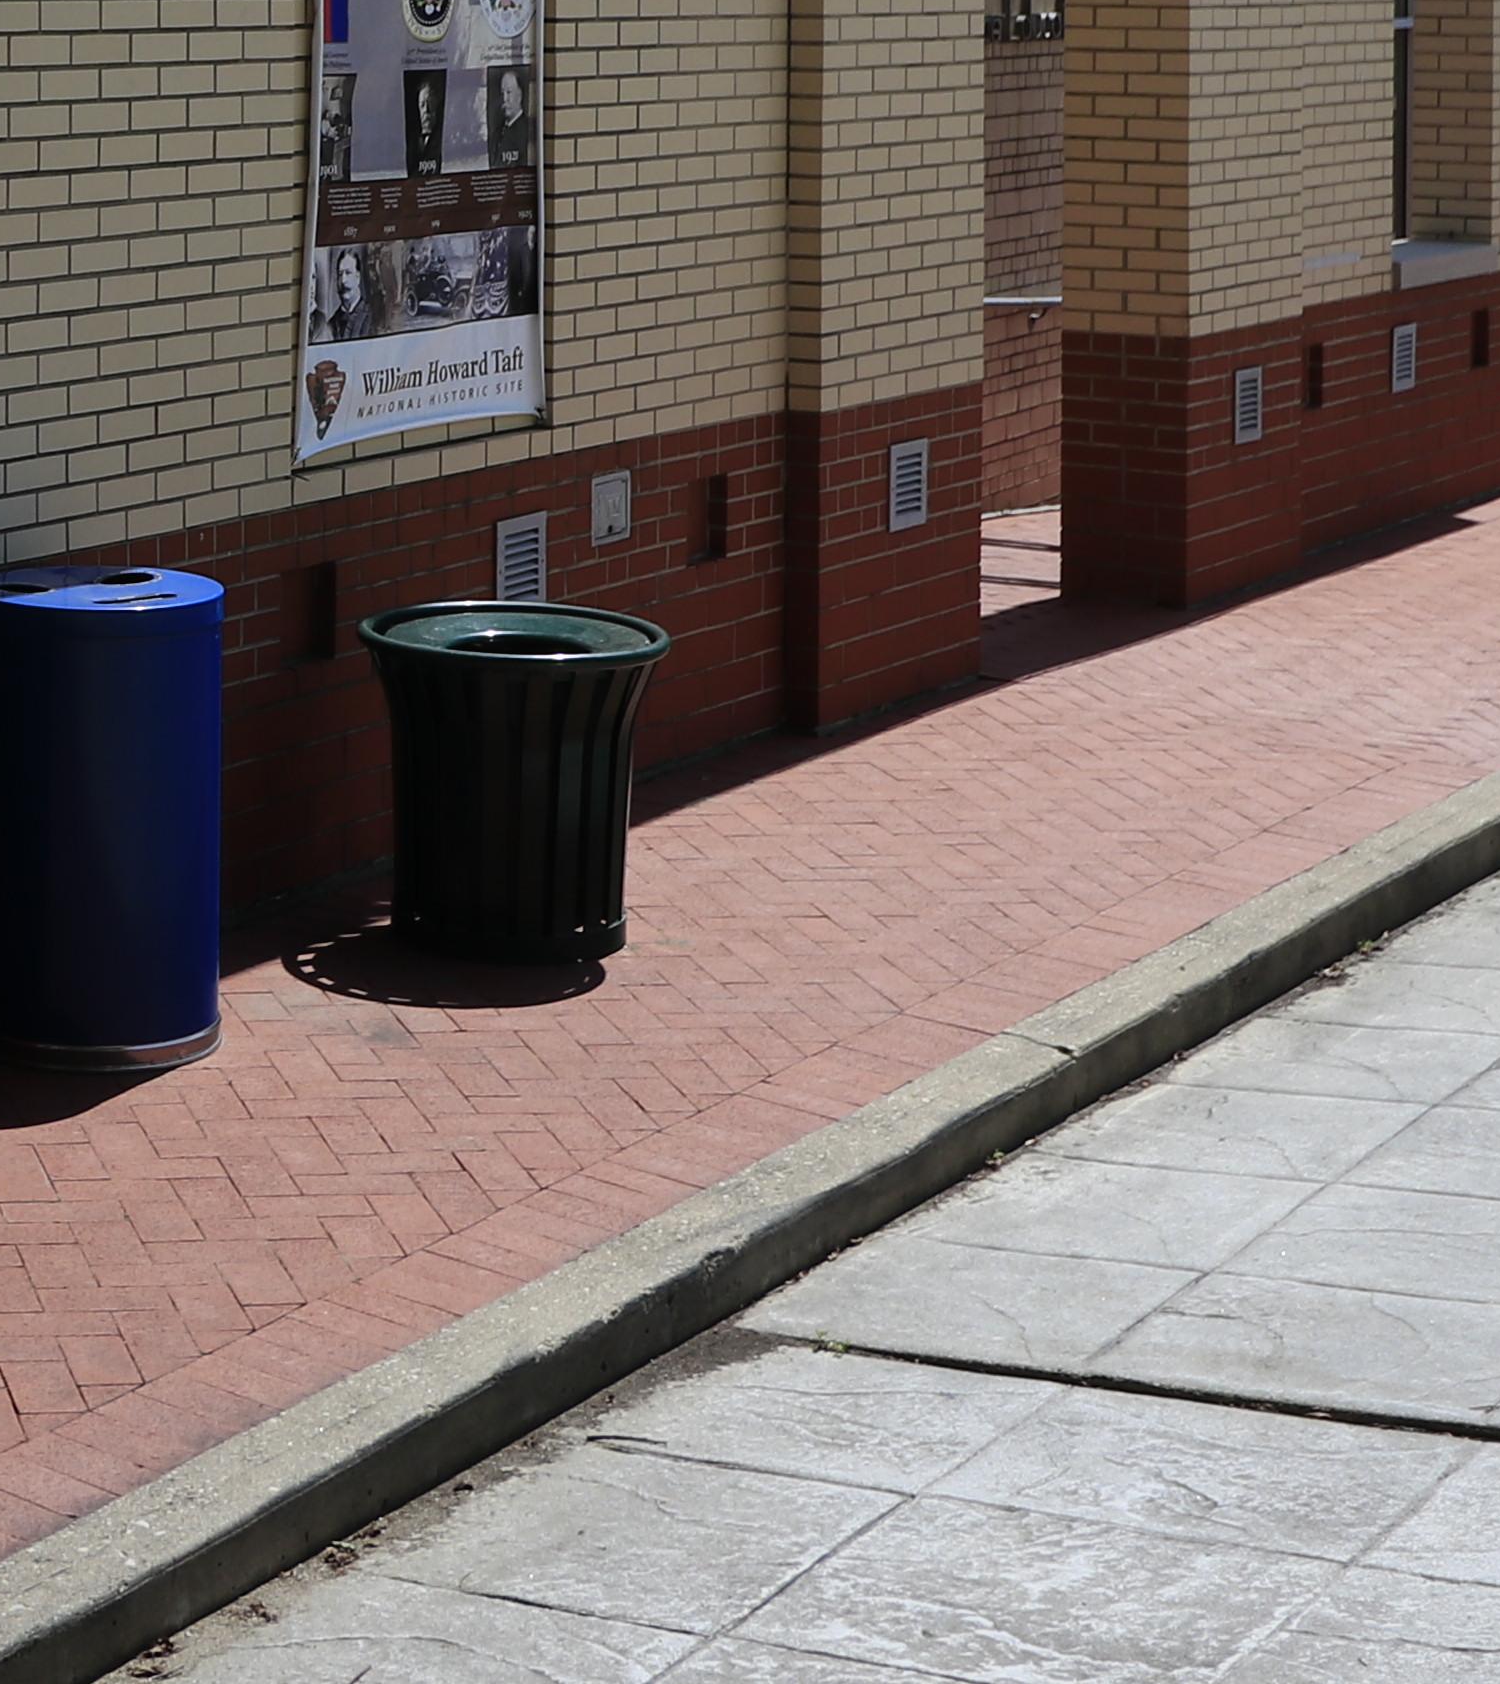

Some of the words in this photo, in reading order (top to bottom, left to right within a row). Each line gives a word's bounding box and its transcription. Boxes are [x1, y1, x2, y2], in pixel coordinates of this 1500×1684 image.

[362, 366, 423, 397] William
[426, 351, 488, 387] Howard
[490, 345, 524, 374] Taft
[356, 398, 422, 419] NATIONAL
[429, 384, 488, 405] HISTORIC
[495, 379, 524, 394] SITE
